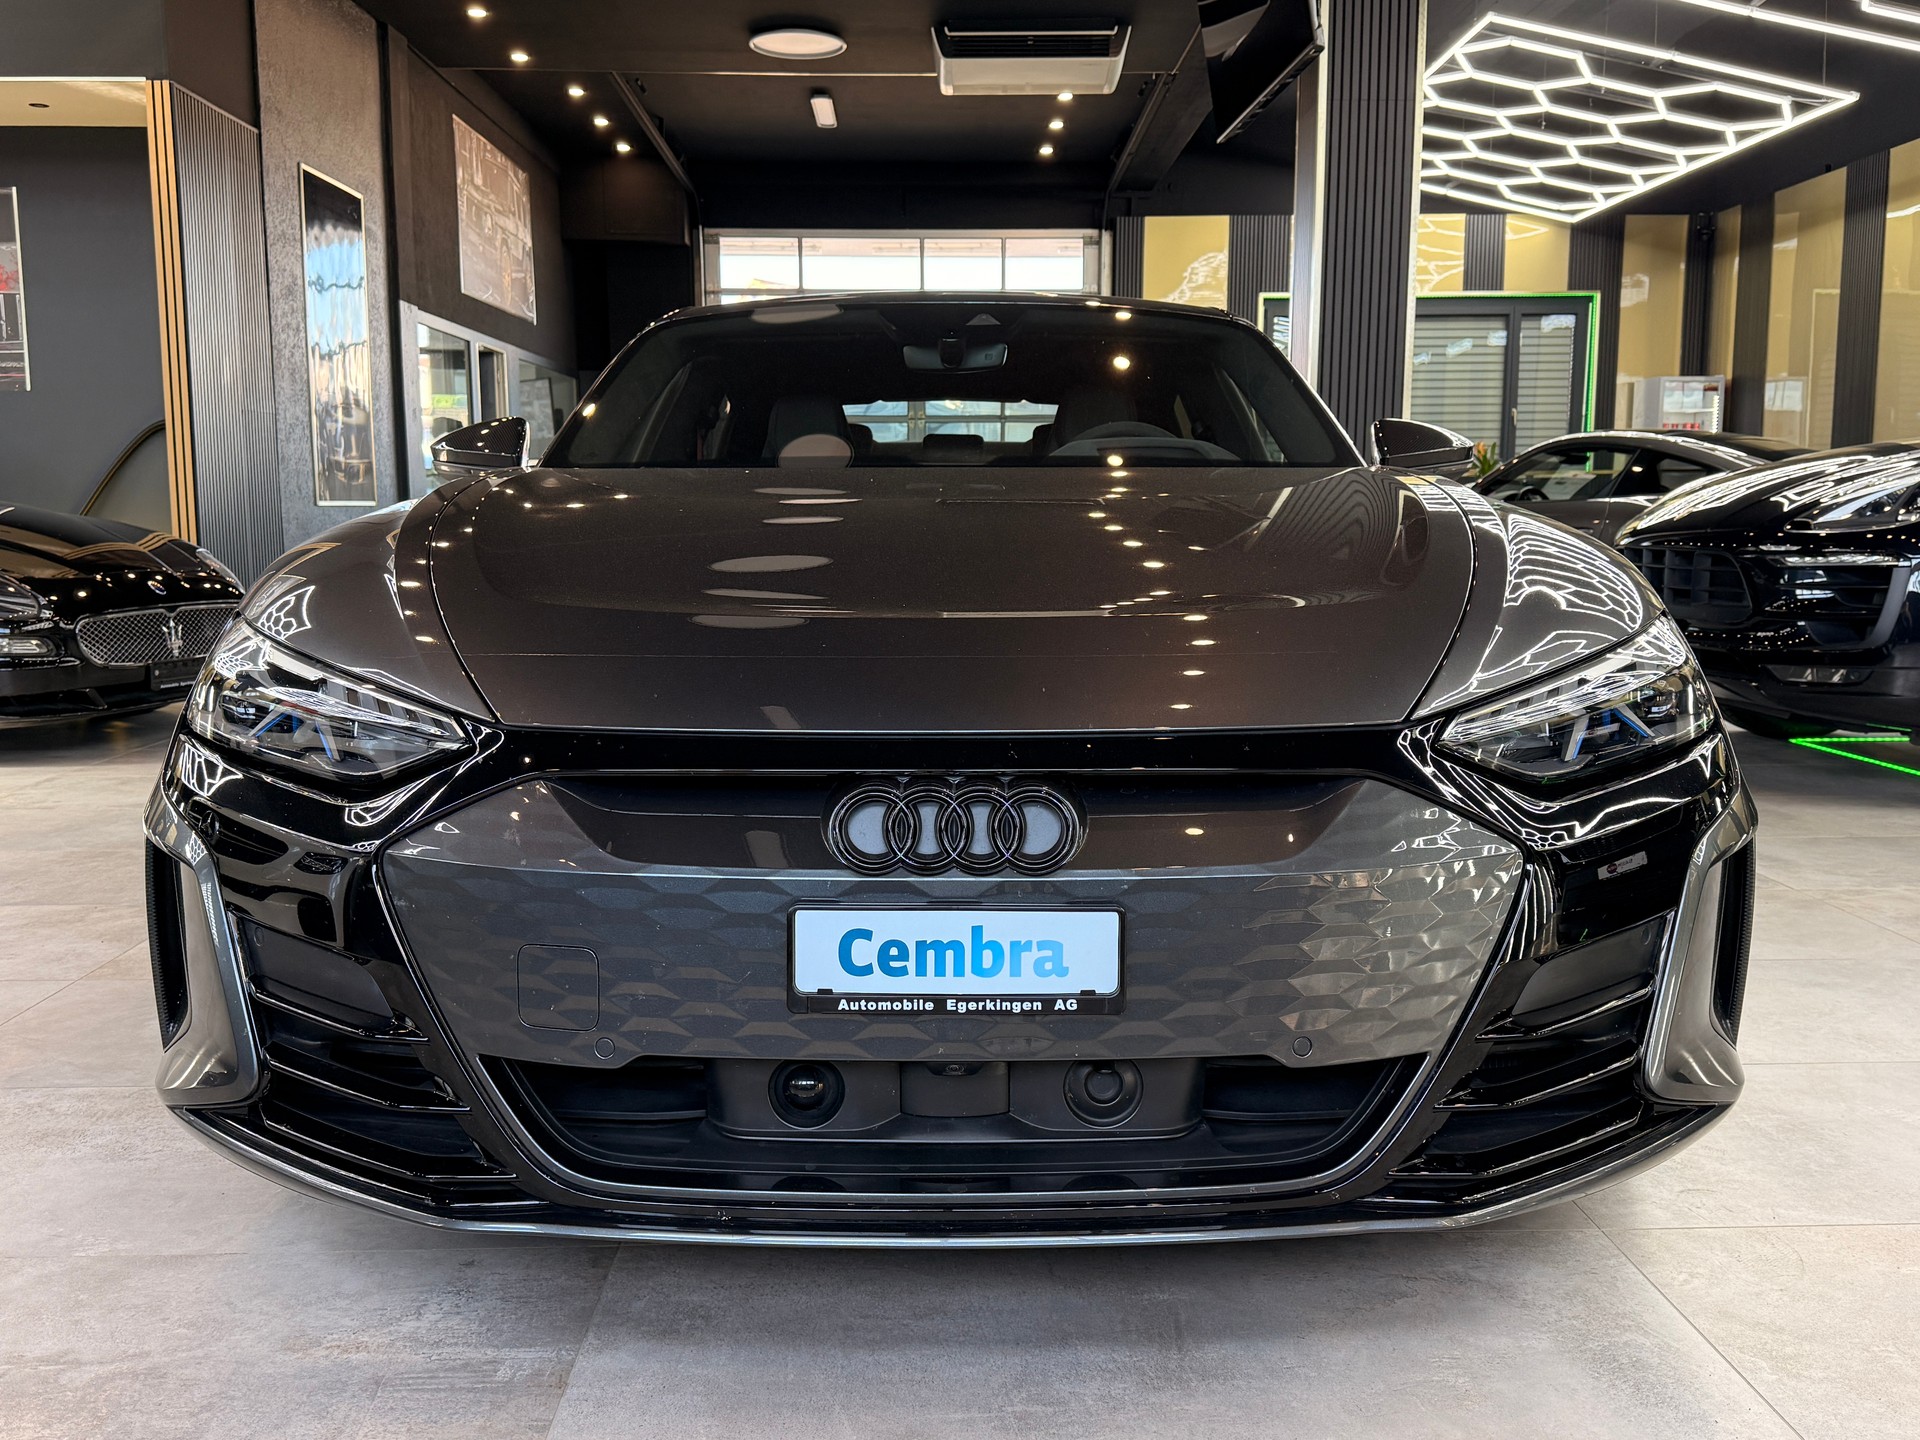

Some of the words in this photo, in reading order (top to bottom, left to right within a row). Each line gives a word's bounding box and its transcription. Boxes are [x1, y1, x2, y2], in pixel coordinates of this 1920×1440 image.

[838, 924, 1070, 979] Cembra
[837, 998, 935, 1011] Automobile
[946, 998, 1042, 1013] Egerkingen
[1054, 998, 1078, 1011] AG
